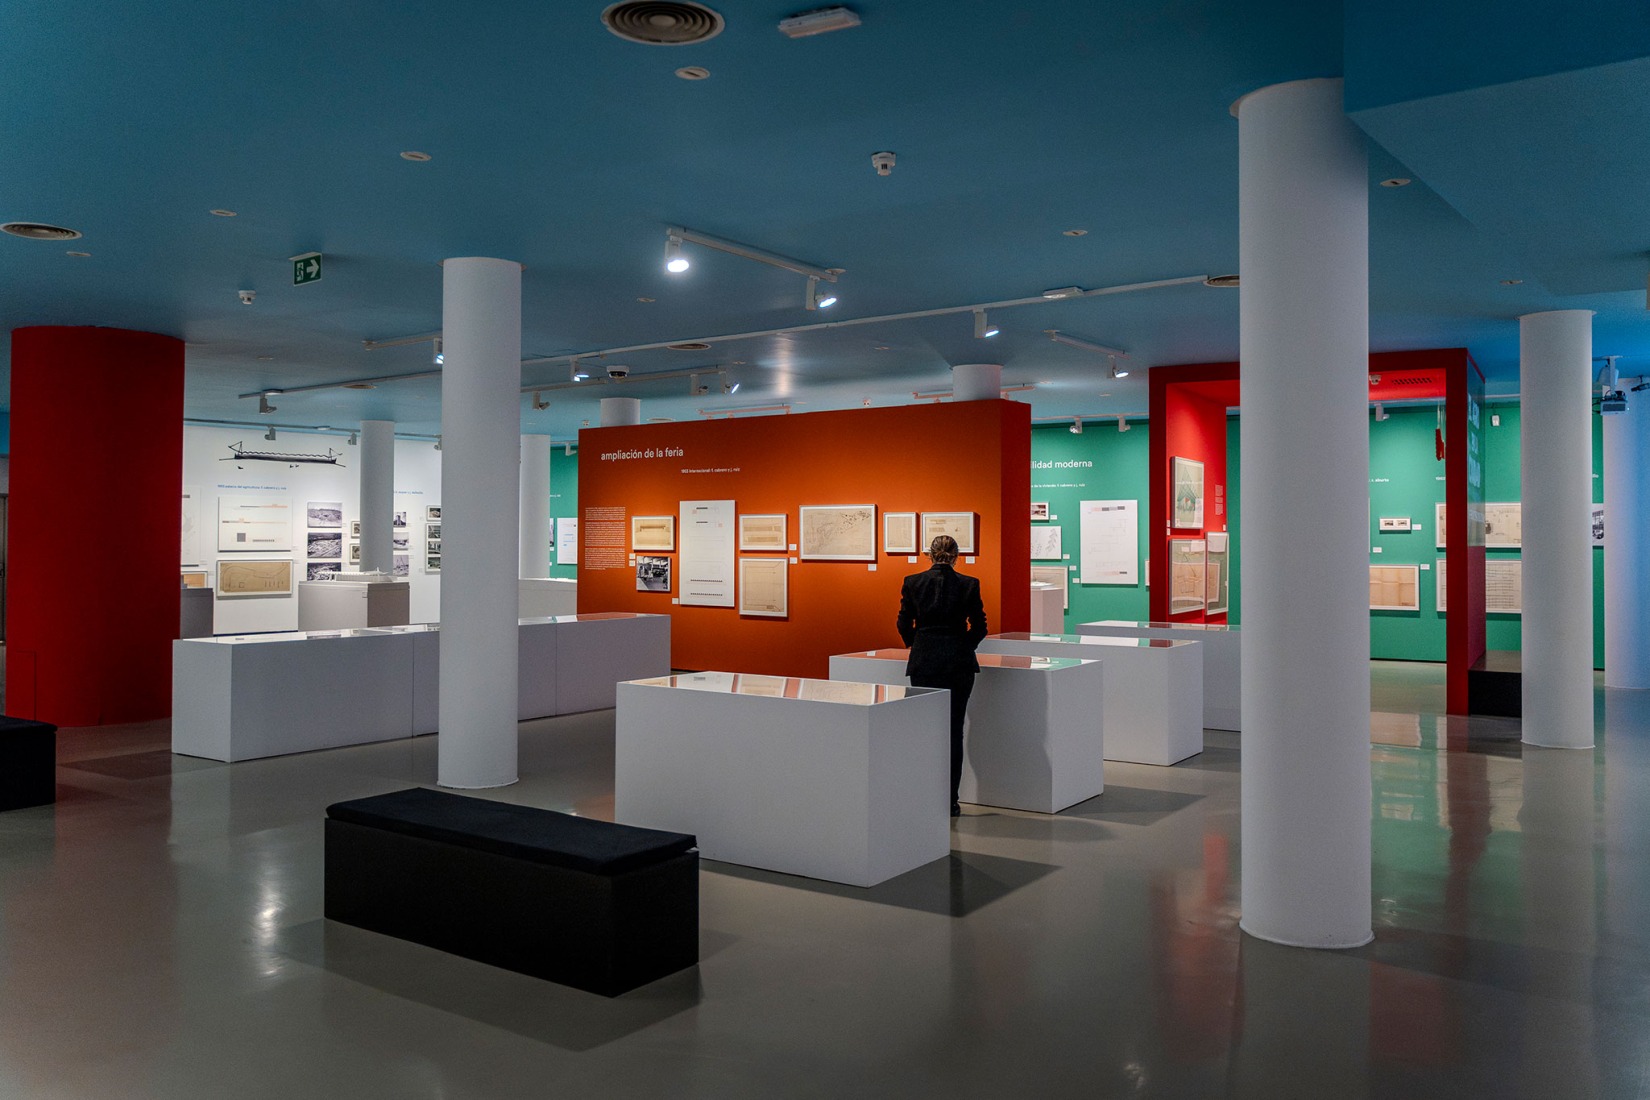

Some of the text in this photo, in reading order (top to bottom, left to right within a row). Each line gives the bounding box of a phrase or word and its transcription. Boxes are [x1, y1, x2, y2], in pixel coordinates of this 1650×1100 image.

[601, 446, 684, 462] ampliación de la feria
[1054, 459, 1093, 468] moderna
